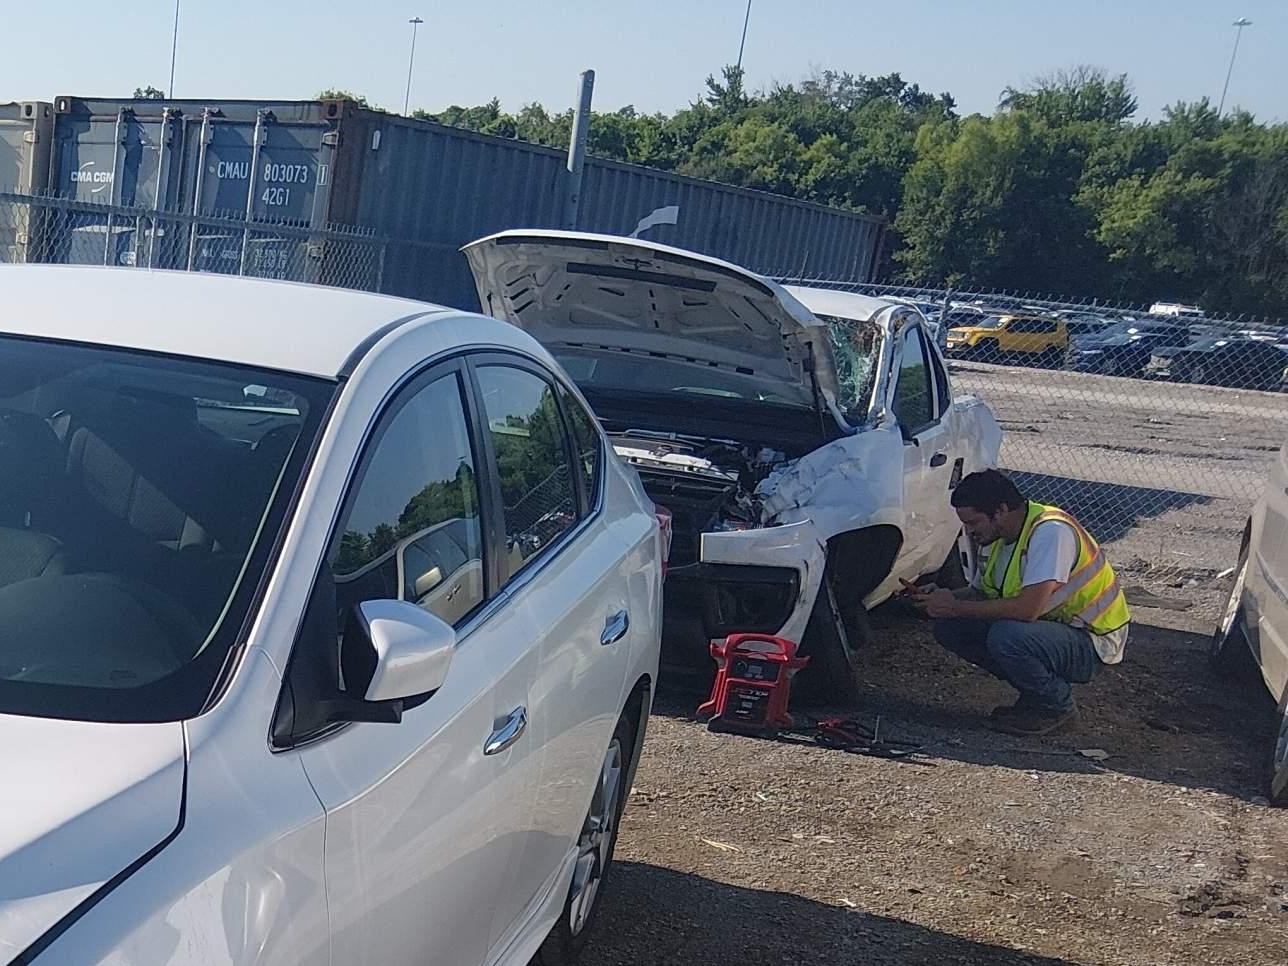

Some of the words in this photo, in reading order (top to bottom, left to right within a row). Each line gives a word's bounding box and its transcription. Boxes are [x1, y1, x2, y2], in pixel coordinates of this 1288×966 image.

[70, 171, 92, 183] CMA
[217, 161, 249, 179] CMAU
[263, 163, 308, 183] 803073
[262, 187, 290, 206] 42G1
